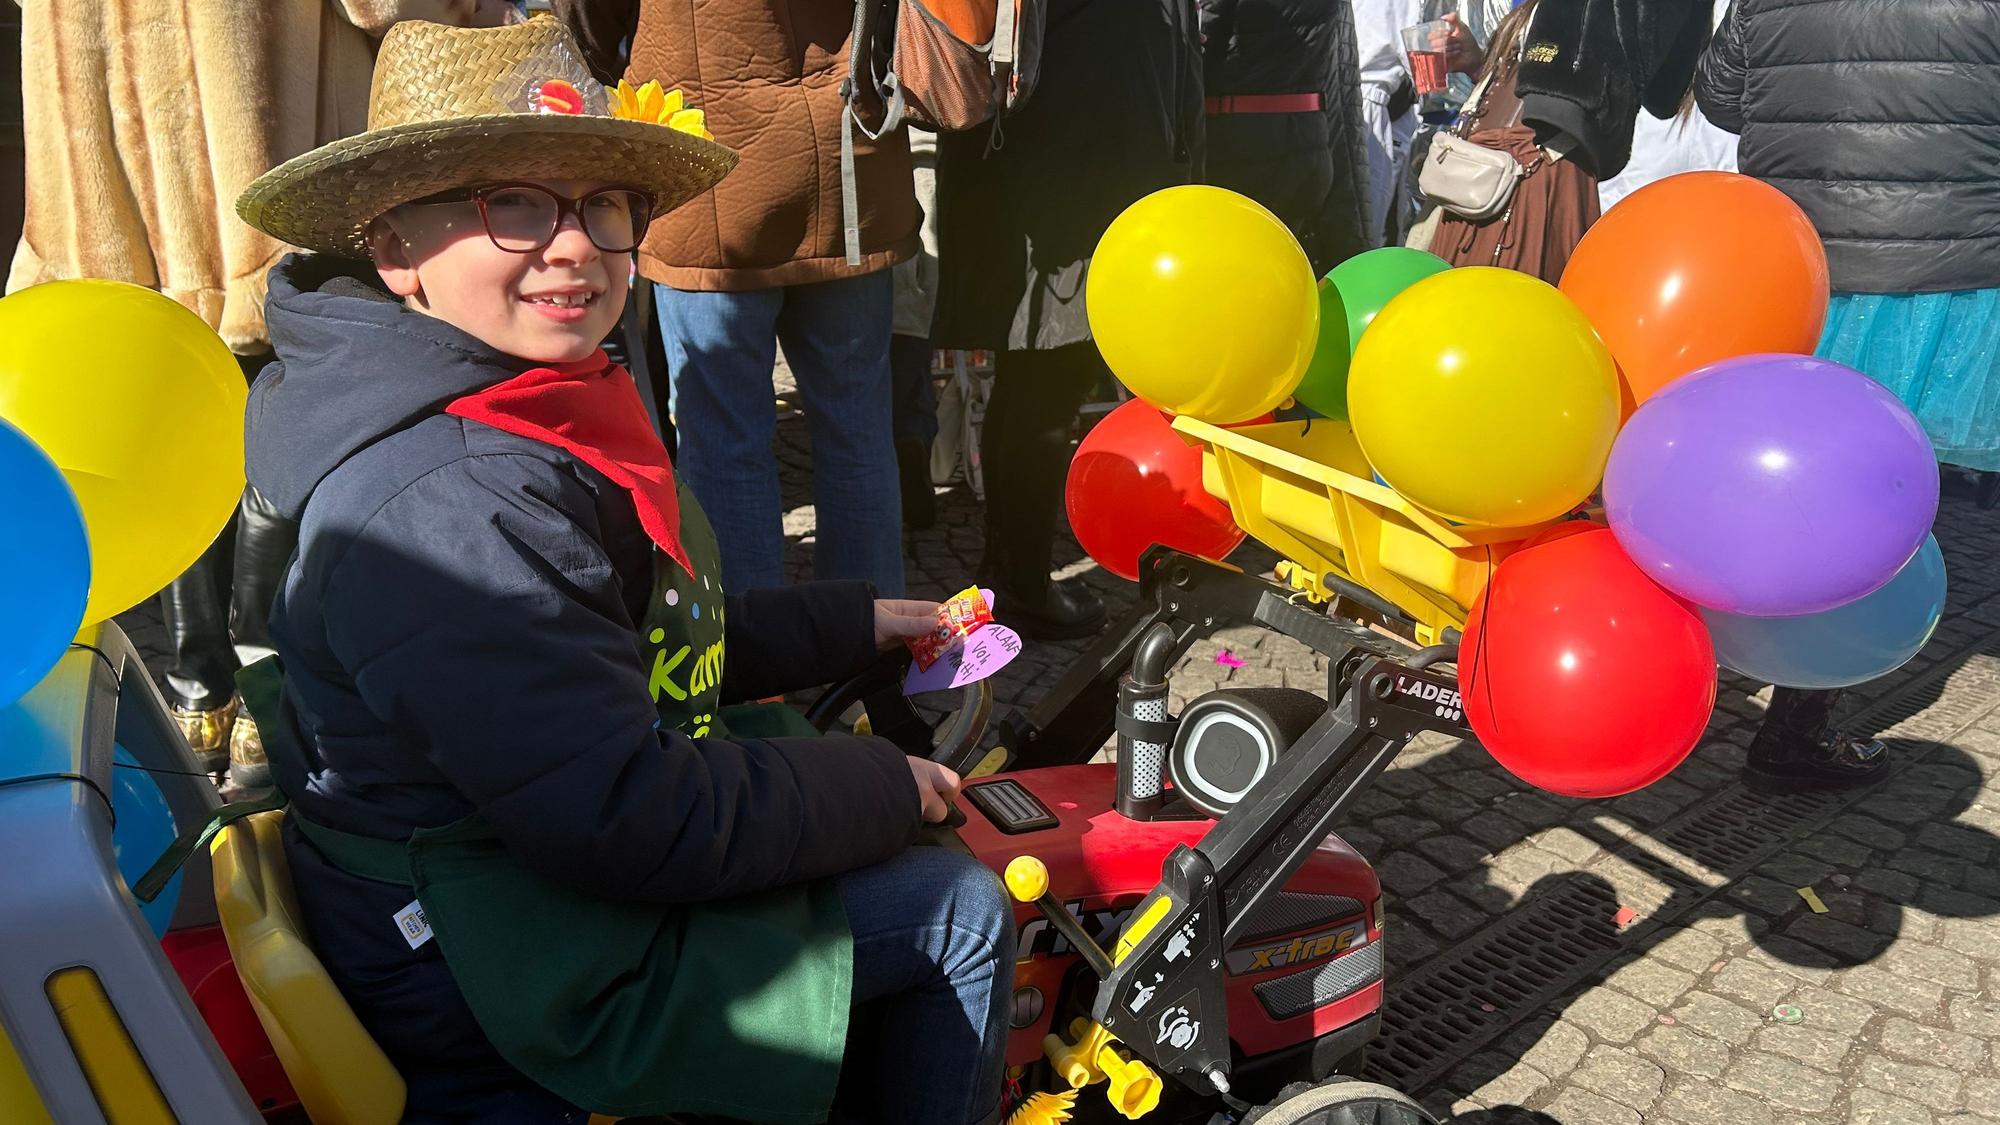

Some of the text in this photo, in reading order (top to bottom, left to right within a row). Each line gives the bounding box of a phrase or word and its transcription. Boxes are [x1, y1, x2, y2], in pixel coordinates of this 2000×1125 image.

[988, 626, 1021, 653] ALAAF
[1395, 676, 1462, 709] LADER
[415, 909, 429, 928] LINK
